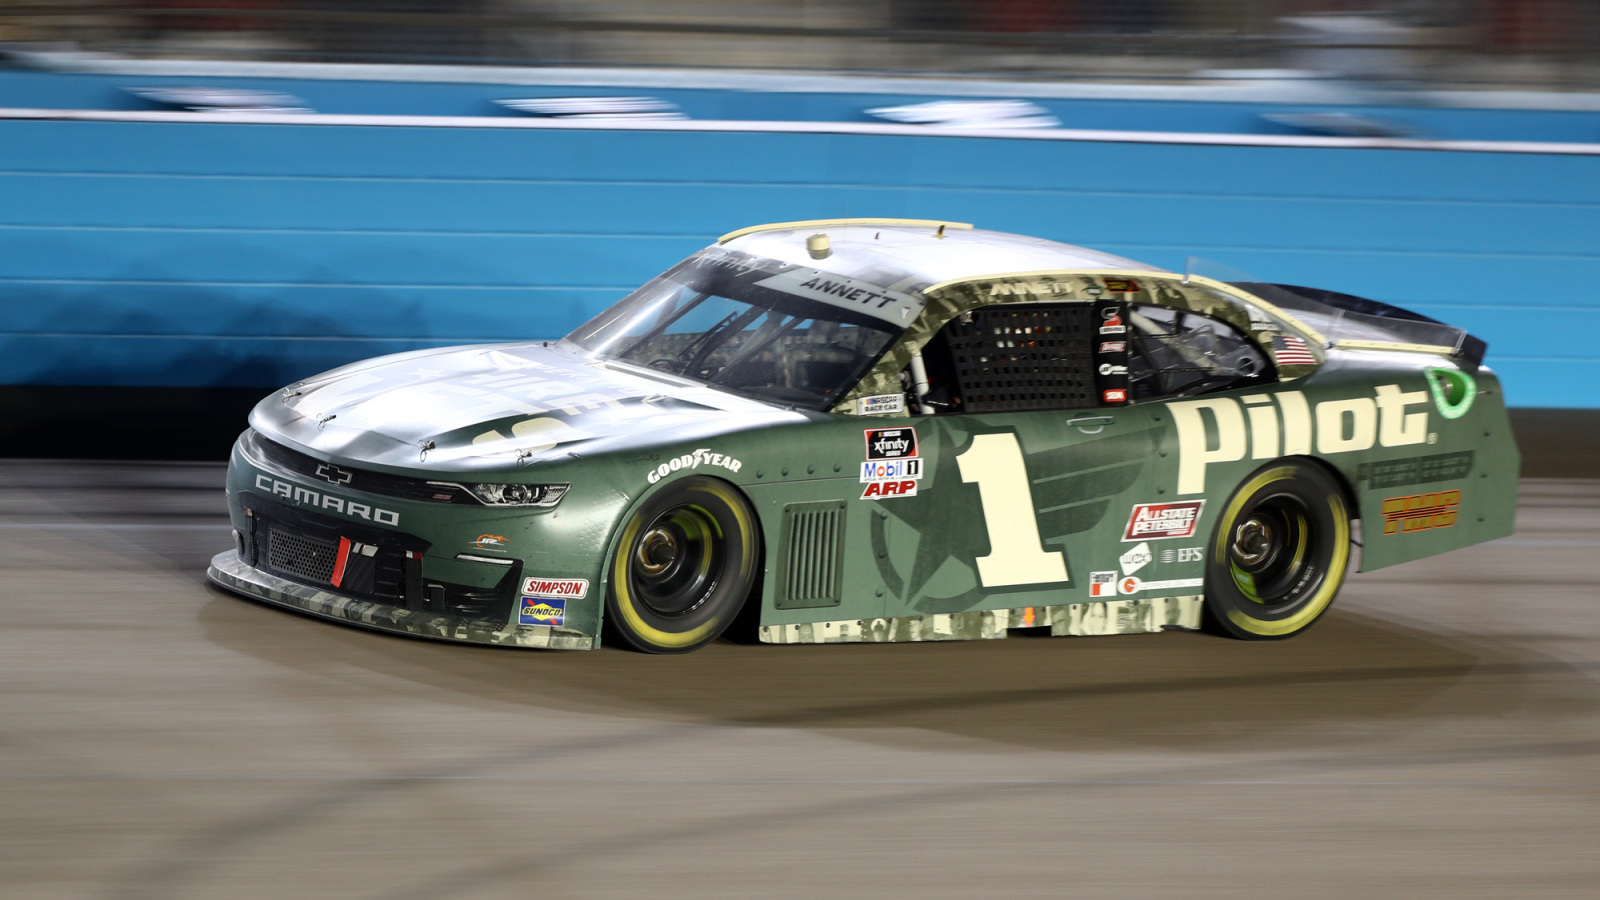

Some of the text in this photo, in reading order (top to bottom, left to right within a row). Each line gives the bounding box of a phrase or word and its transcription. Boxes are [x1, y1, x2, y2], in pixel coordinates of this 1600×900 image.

[800, 277, 897, 308] ANNETT
[989, 281, 1072, 296] ANNETT
[874, 438, 909, 454] xfinity
[647, 451, 742, 484] GOODYEAR
[864, 460, 918, 478] Mobil 1
[864, 481, 915, 496] ARP
[255, 474, 400, 526] CAMARO
[956, 433, 1069, 587] 1
[1178, 547, 1204, 562] EFS
[527, 580, 583, 595] SIMPSON
[523, 607, 561, 616] SUNOCO
